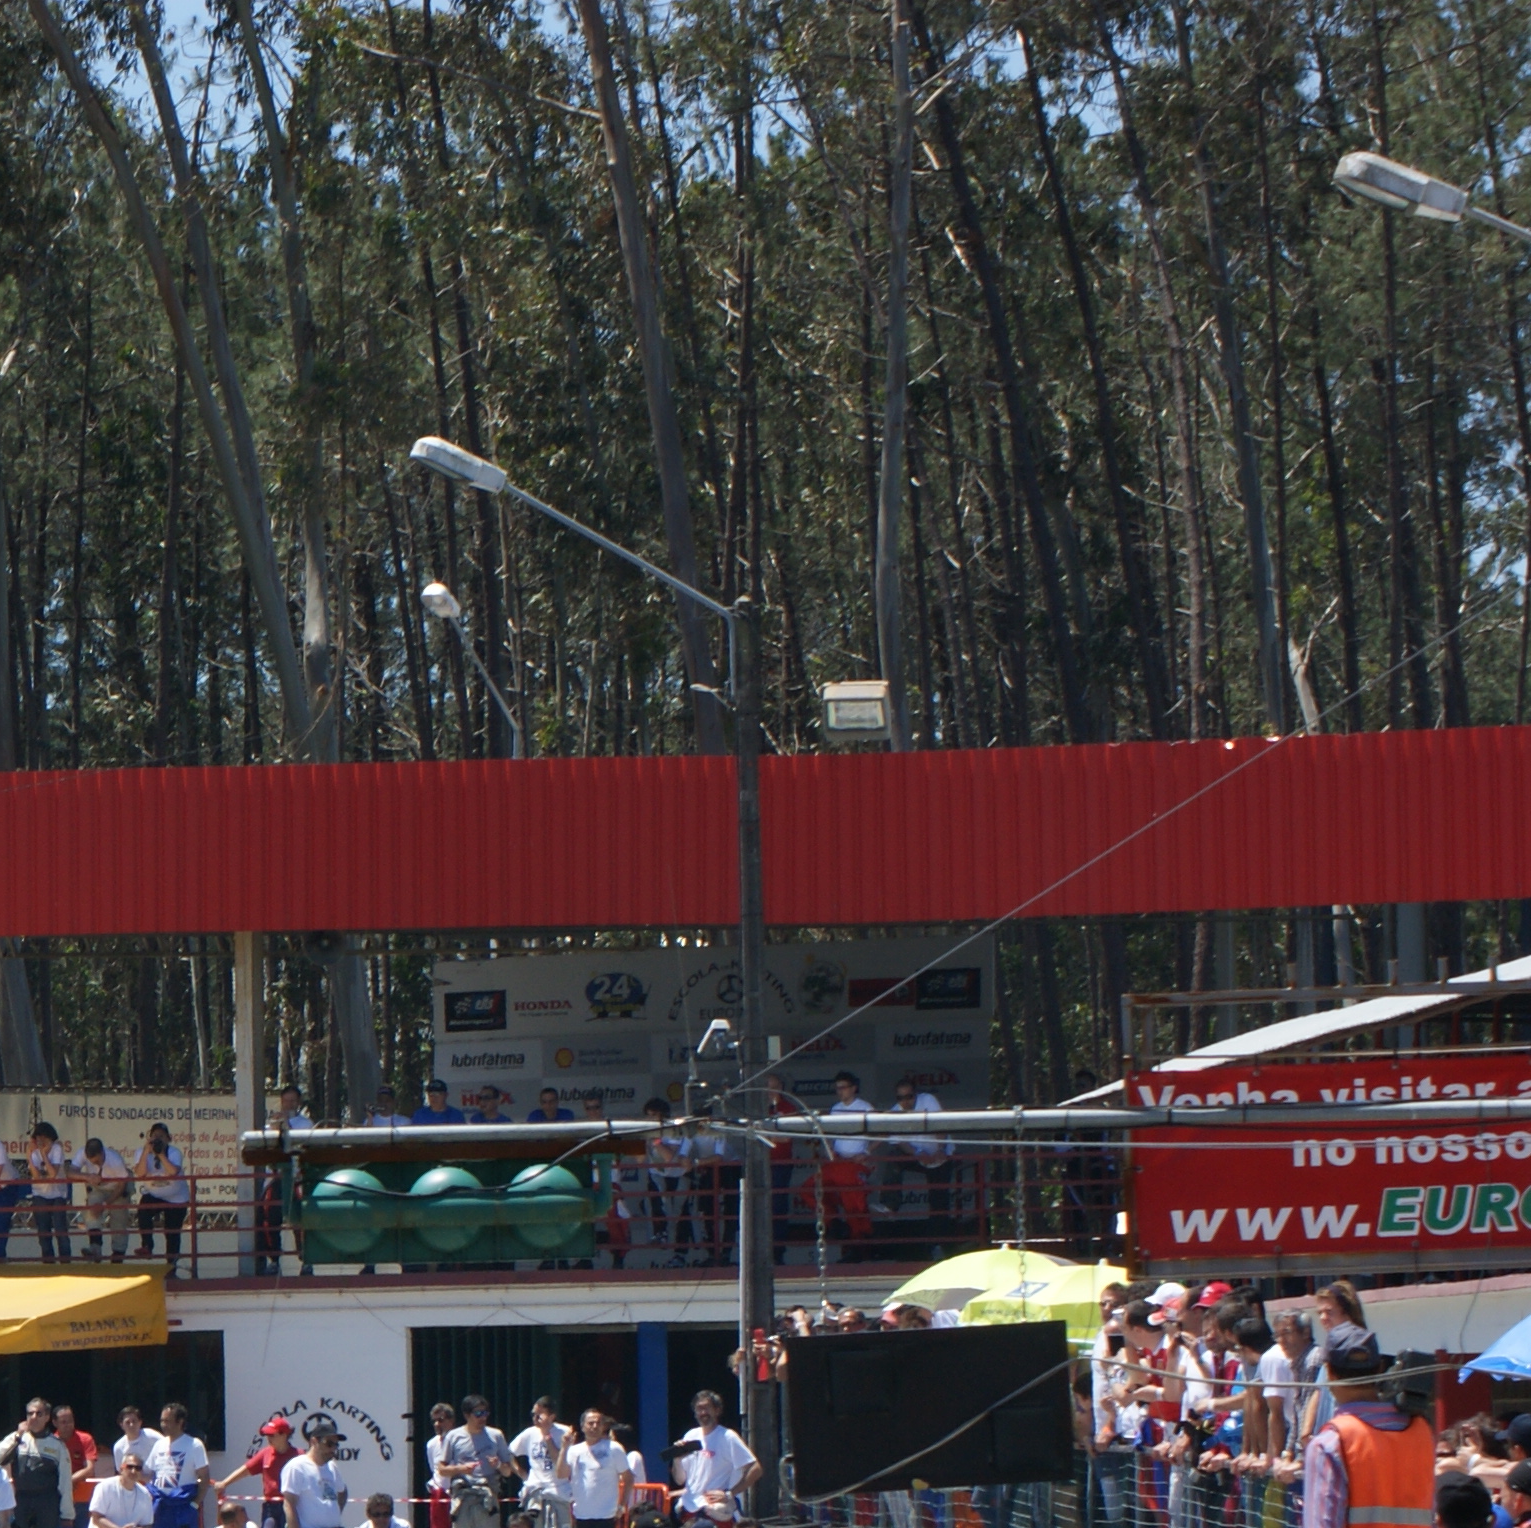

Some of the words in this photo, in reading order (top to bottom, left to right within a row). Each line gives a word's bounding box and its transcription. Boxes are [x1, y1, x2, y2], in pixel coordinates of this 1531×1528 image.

[514, 1000, 573, 1012] HONDA
[59, 1104, 96, 1118] FUROS
[99, 1106, 105, 1118] E
[108, 1107, 174, 1120] SONDAGENS
[176, 1107, 191, 1120] DE
[1293, 1138, 1356, 1167] no
[1375, 1130, 1531, 1165] nosso
[70, 1316, 137, 1333] BALANÇAS
[320, 1397, 394, 1461] KARTING
